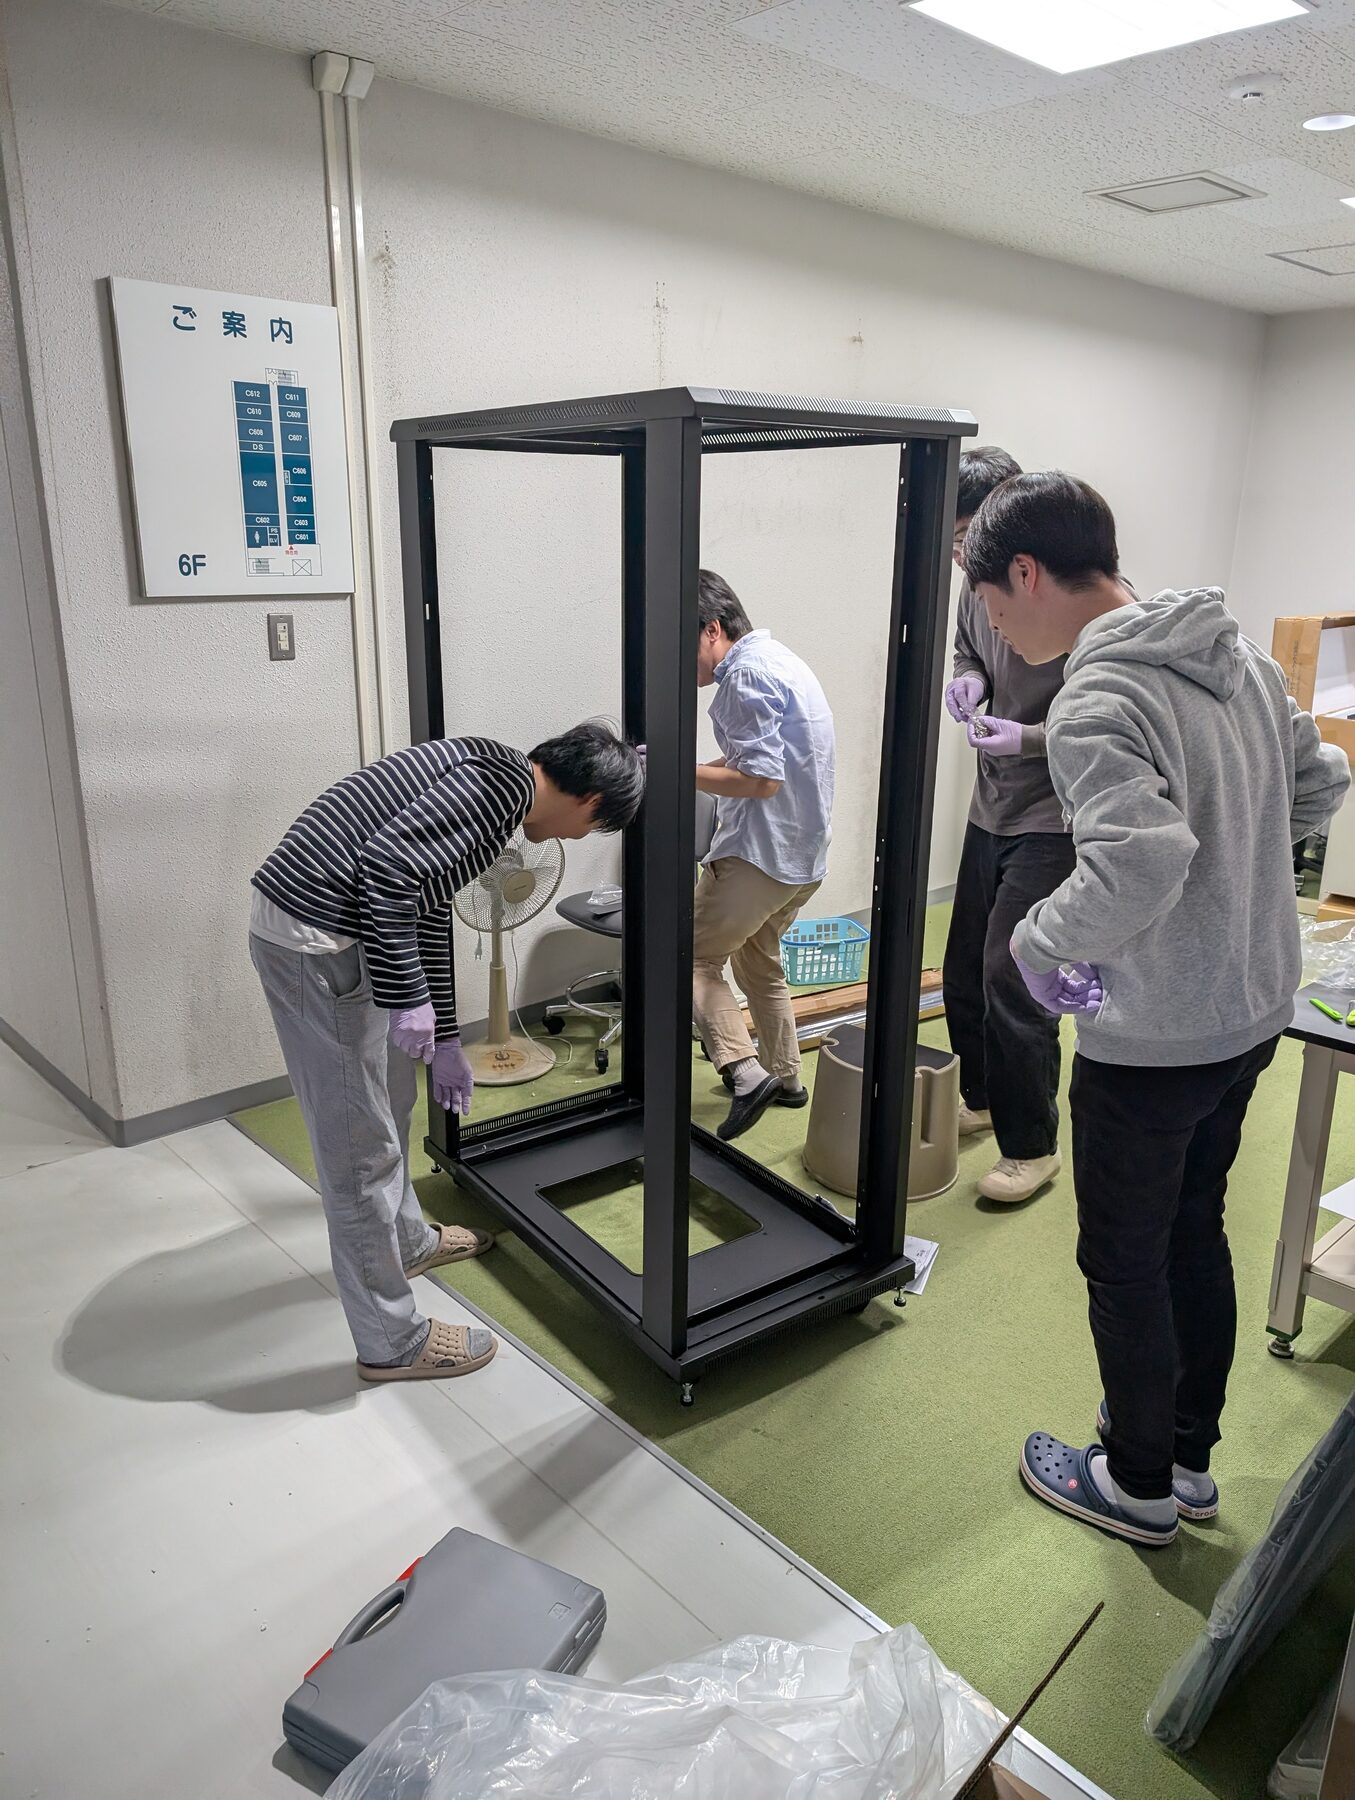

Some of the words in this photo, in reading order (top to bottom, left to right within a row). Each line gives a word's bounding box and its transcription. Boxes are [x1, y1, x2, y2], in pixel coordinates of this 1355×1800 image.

[172, 304, 294, 344] ご案内
[285, 393, 299, 401] C611
[178, 553, 207, 577] 6F
